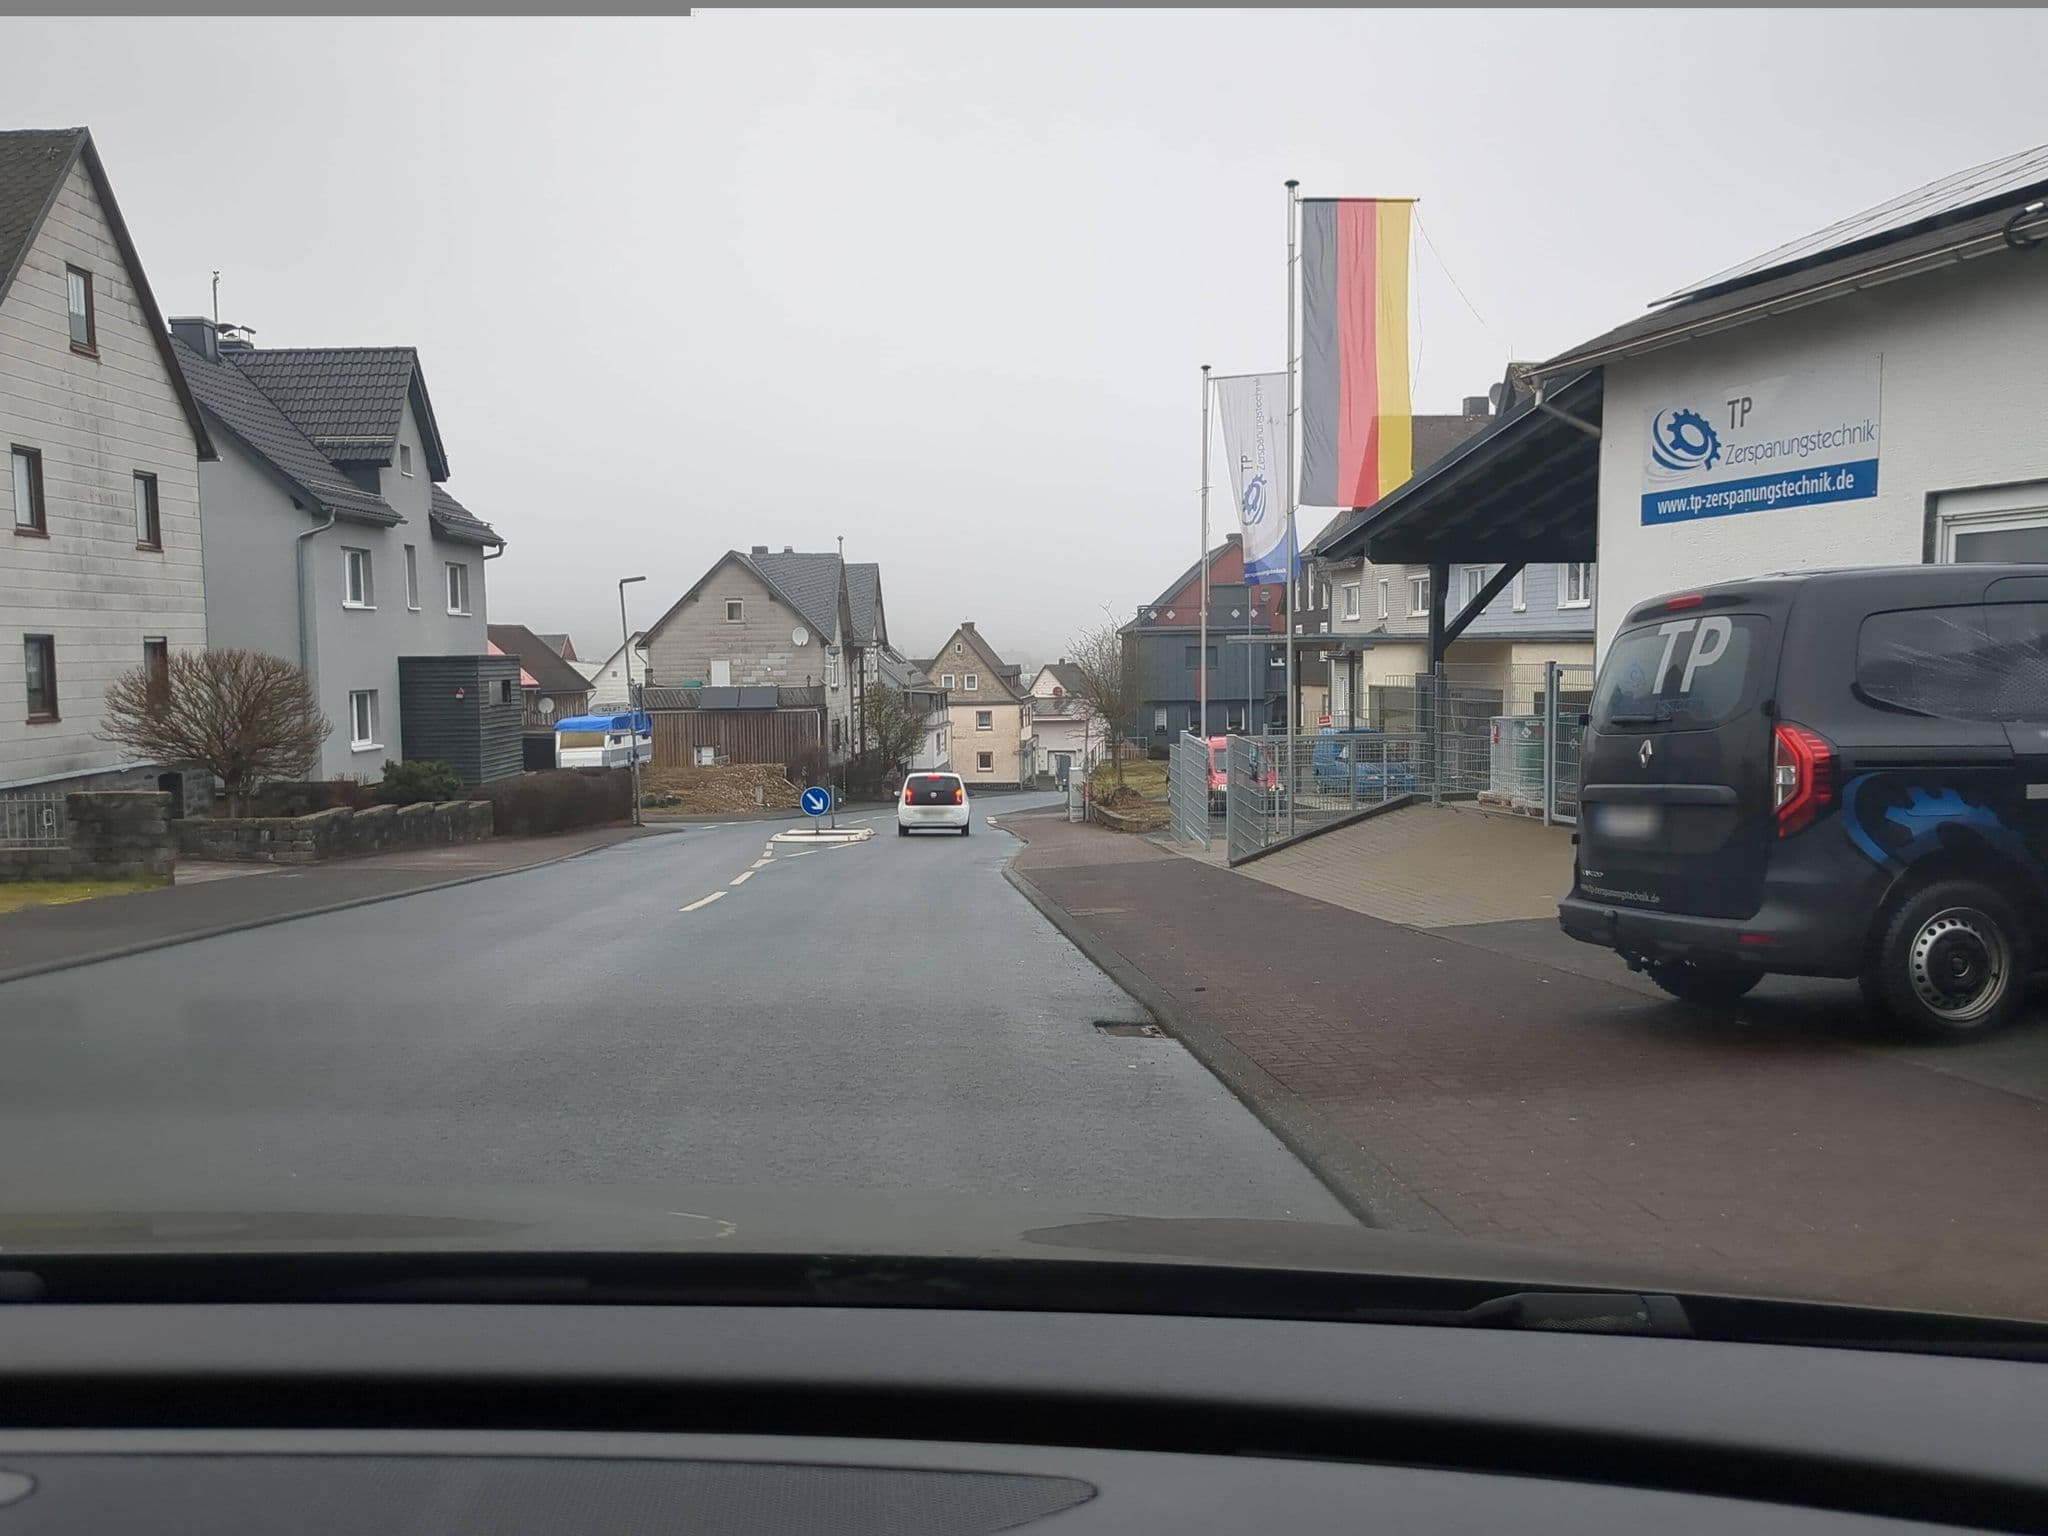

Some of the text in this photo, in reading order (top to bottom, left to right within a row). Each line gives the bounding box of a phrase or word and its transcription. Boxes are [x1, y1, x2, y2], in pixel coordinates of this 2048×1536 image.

[1727, 397, 1753, 429] TP
[1241, 455, 1253, 472] TP
[1726, 419, 1876, 466] Zerspanungstechnik
[1657, 469, 1855, 514] www.tp-zerspanungstechnik.de
[1652, 615, 1732, 695] TP
